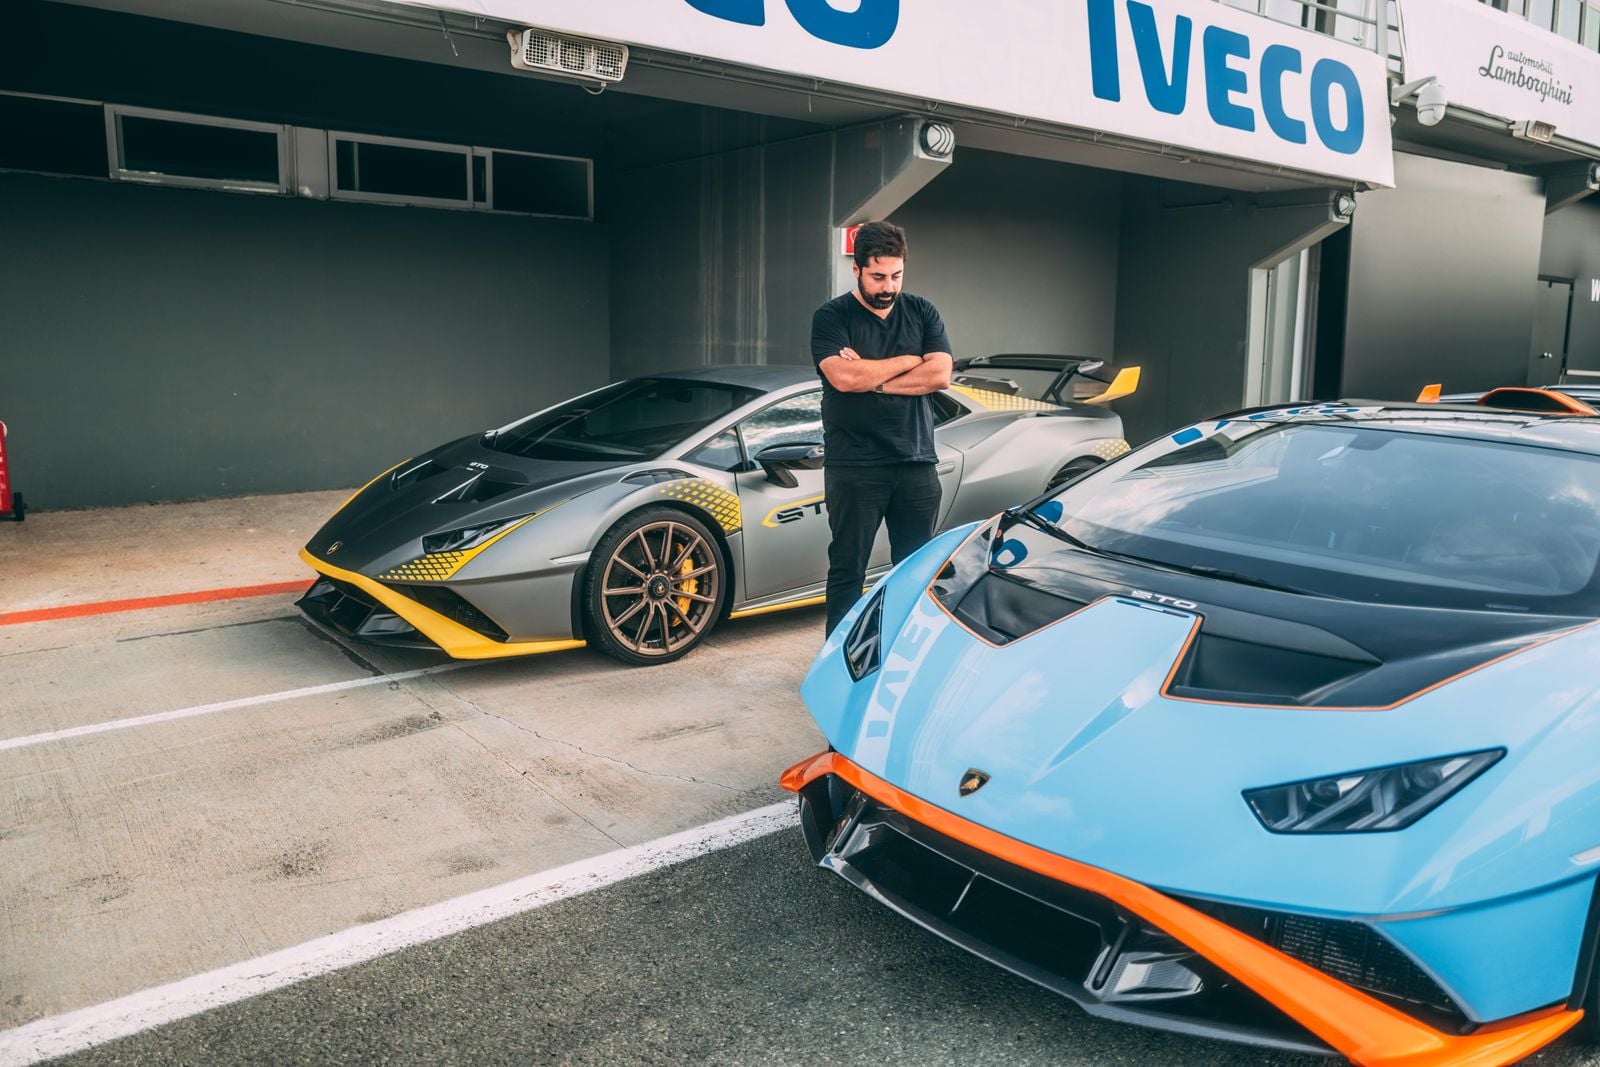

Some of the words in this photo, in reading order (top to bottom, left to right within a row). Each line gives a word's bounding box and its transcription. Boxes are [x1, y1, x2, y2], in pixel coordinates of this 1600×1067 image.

[1508, 51, 1554, 75] automobili
[1087, 0, 1364, 154] IVECO
[1479, 45, 1573, 105] Lamborghini
[469, 461, 489, 469] STO
[777, 500, 826, 523] ST
[1131, 590, 1198, 609] STO
